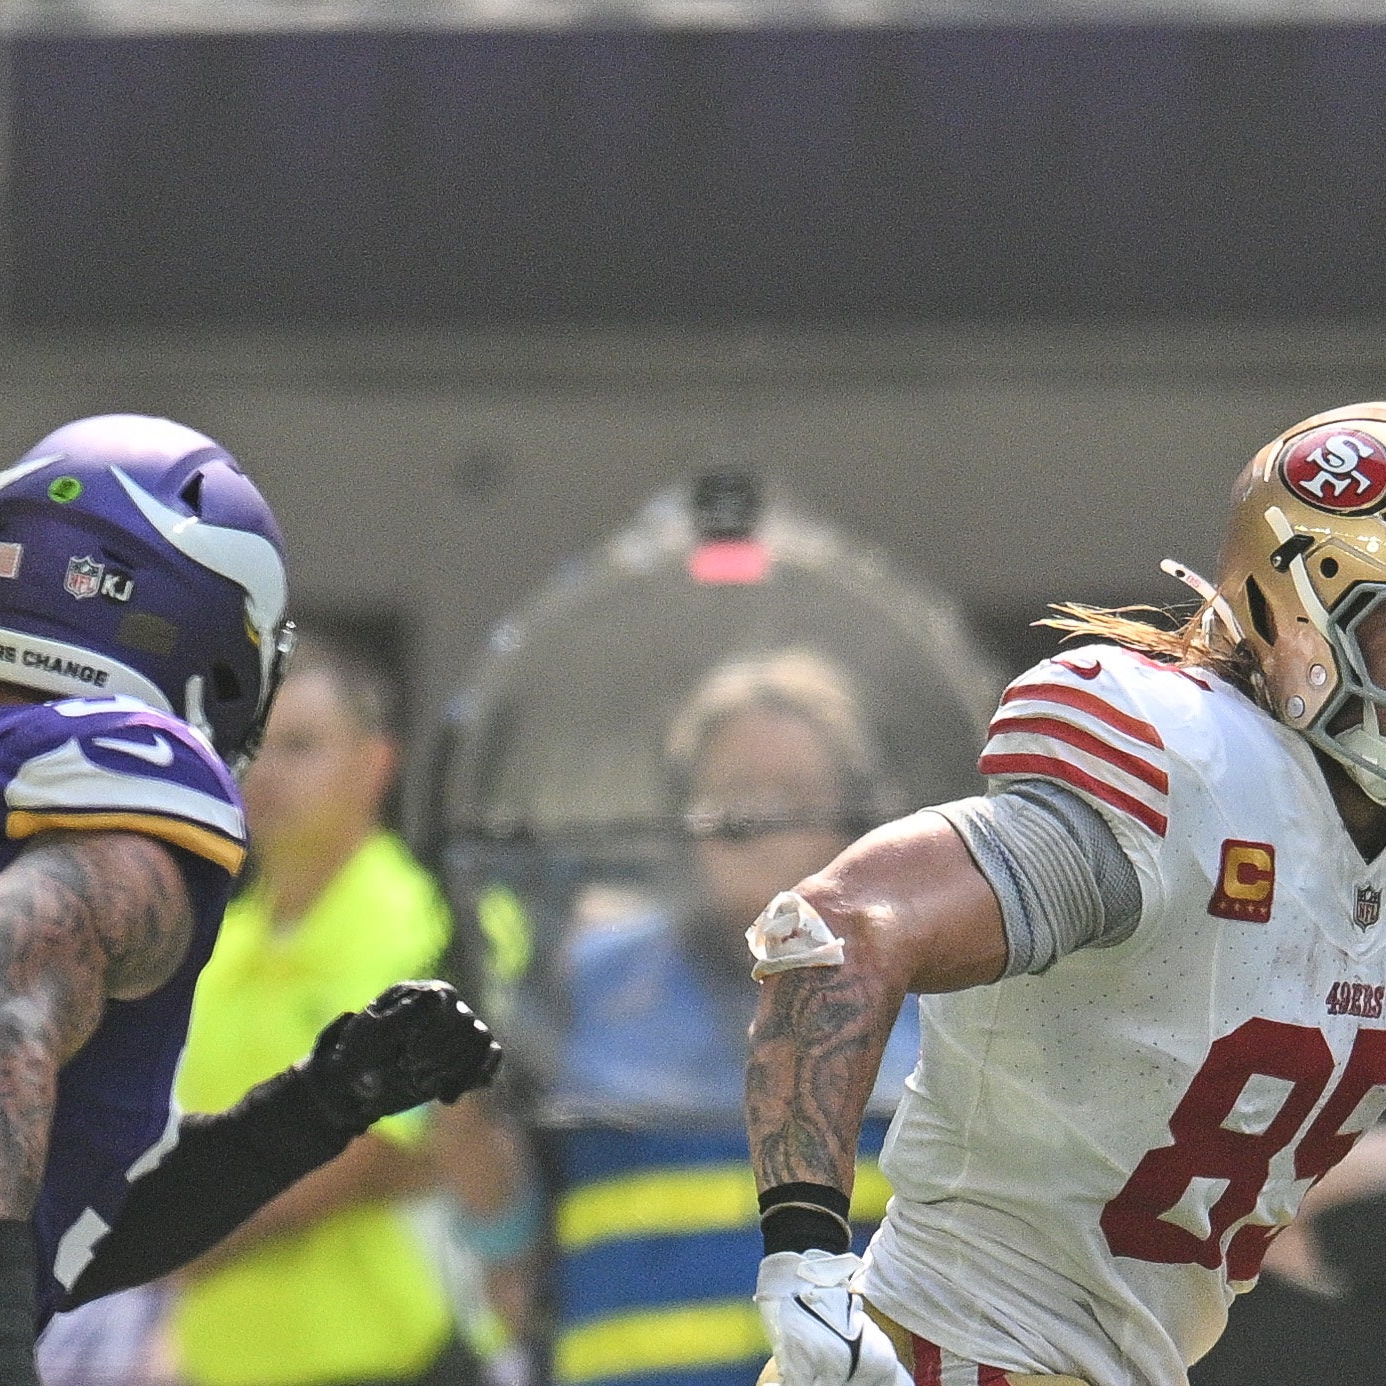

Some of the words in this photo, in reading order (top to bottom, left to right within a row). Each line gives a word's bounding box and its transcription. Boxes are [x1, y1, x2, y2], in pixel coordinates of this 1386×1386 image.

[101, 573, 134, 601] KJ
[21, 650, 109, 688] CHANGE
[1223, 845, 1274, 900] C
[1326, 981, 1385, 1018] 49ERS
